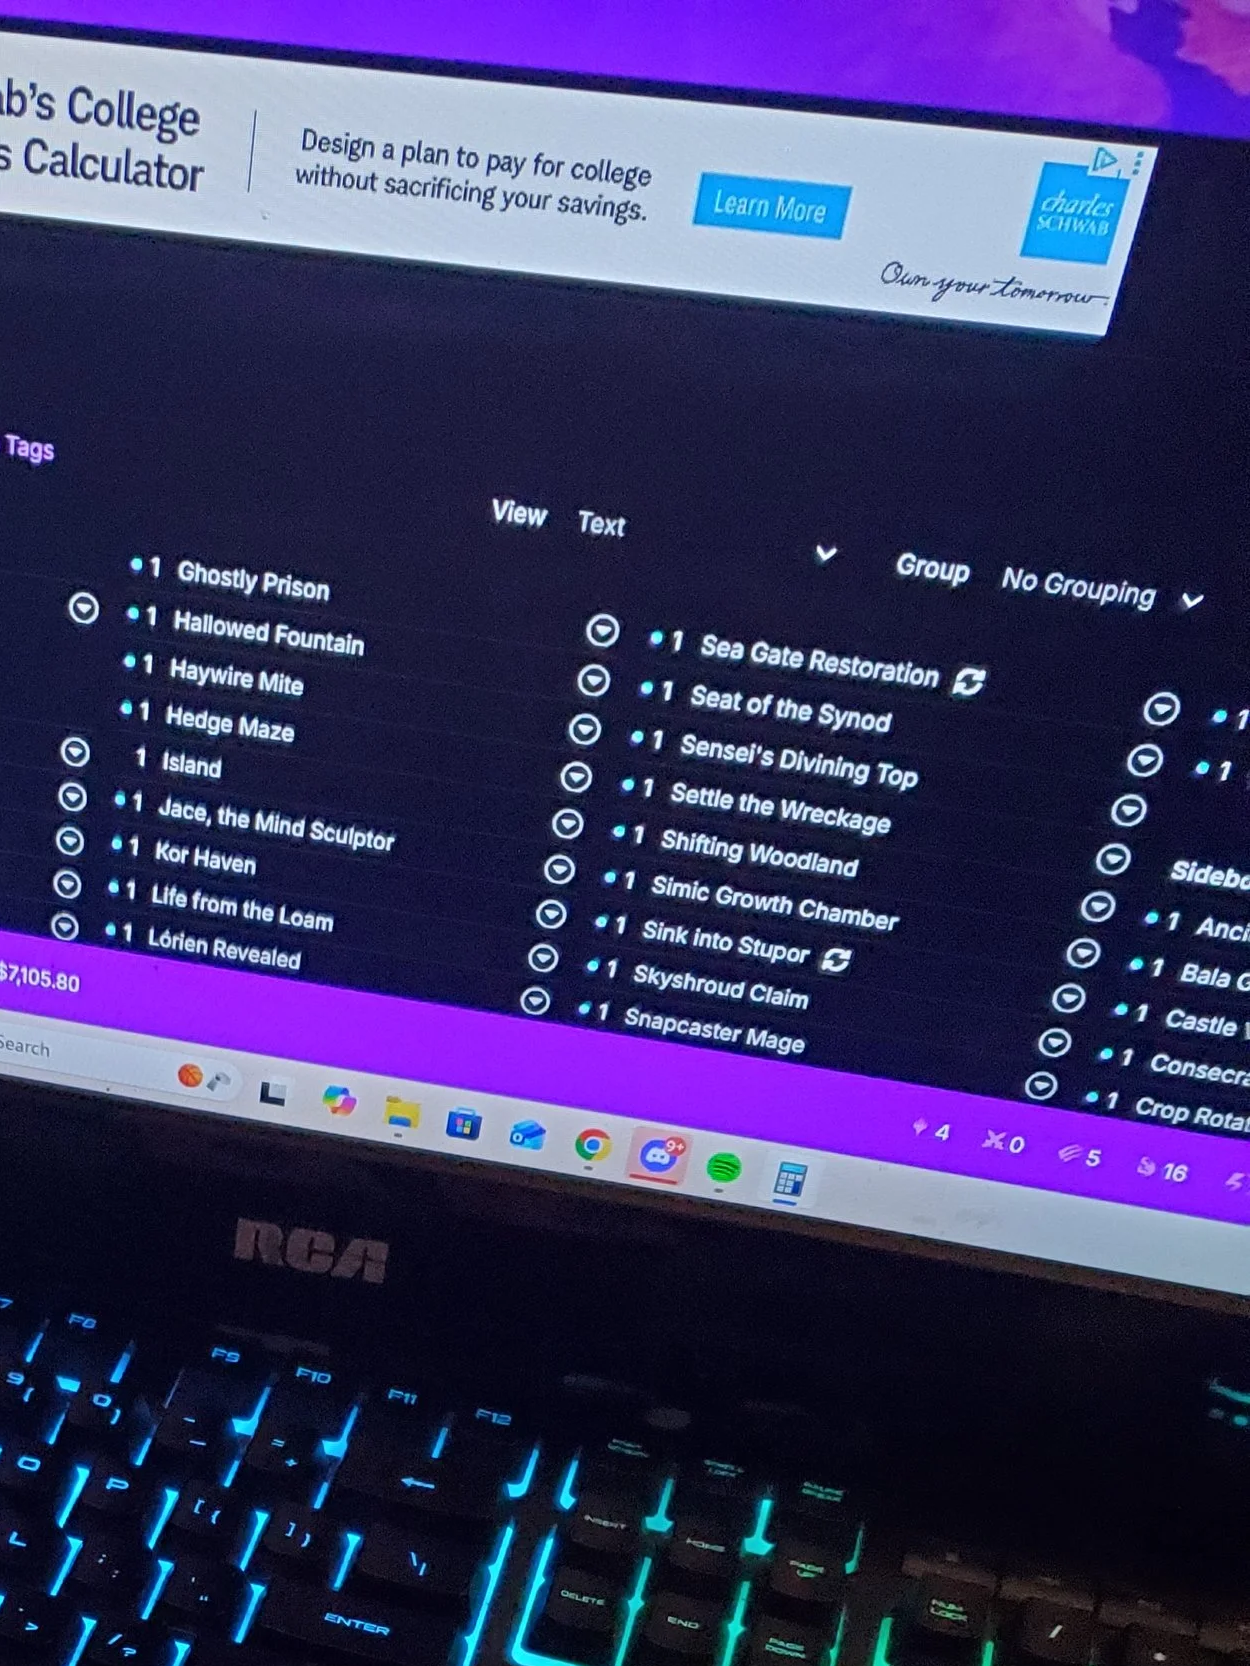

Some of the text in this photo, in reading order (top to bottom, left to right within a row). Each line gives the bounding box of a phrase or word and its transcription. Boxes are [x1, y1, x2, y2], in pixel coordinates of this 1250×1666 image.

[68, 85, 201, 145] College
[23, 136, 206, 194] Calculator
[301, 127, 653, 193] Design a plan to pay for college
[294, 162, 647, 227] without sacrificing your savings.
[714, 189, 827, 225] Learn More
[1040, 192, 1114, 217] charles
[1036, 214, 1111, 237] SCHWAB
[880, 260, 931, 287] Own
[932, 275, 990, 303] your
[4, 433, 55, 465] Tags
[492, 498, 626, 538] View Text
[177, 560, 331, 603] Ghostly Prison
[896, 552, 1157, 612] Group No Grouping
[174, 611, 365, 657] Hallowed Fountain
[701, 633, 940, 689] Sea Gate Restoration
[162, 750, 222, 780] Island
[680, 734, 919, 792] Sensei's Divining Top
[158, 796, 396, 853] Jace, the Mind Sculptor
[151, 884, 334, 933] Life from the Loam
[651, 875, 900, 933] Simic Growth Chamber
[642, 920, 811, 967] Sink into Stupor
[1196, 916, 1250, 943] Anci
[213, 939, 302, 972] Revealed
[1180, 963, 1231, 989] Bala
[624, 1008, 806, 1057] Snapcaster Mage
[1165, 1009, 1238, 1038] Castle
[1135, 1096, 1190, 1126] Crop
[1163, 1162, 1189, 1183] 16
[233, 1217, 390, 1284] RCA
[560, 1588, 606, 1607] DELETE
[323, 1611, 391, 1636] ENTER
[667, 1615, 700, 1630] END
